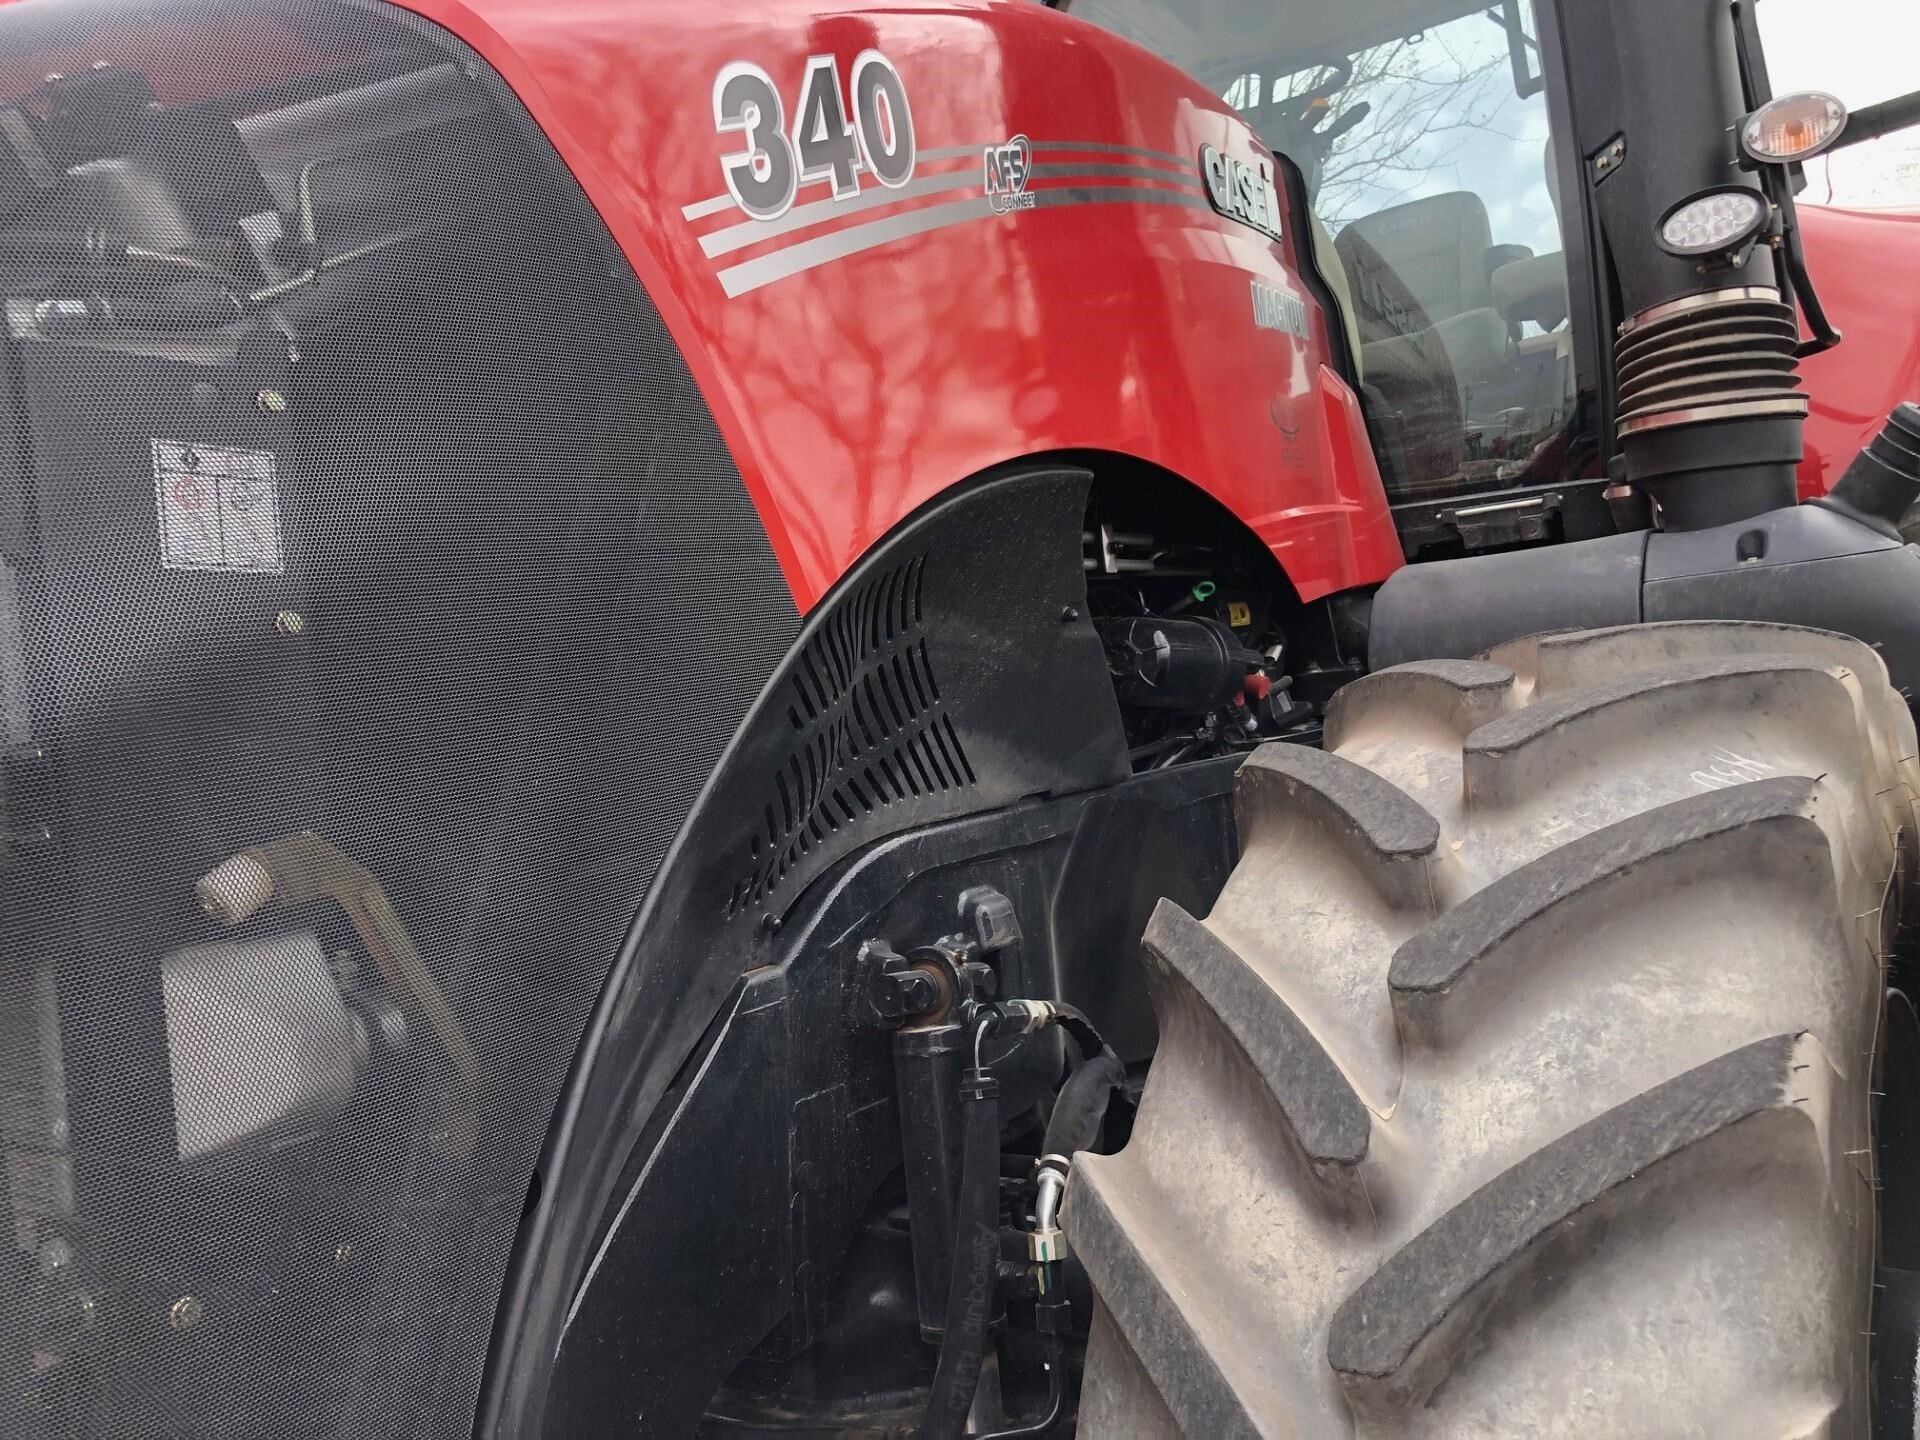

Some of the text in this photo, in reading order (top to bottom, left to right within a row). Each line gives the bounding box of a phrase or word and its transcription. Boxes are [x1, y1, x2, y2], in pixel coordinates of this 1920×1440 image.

[712, 48, 915, 222] 340
[984, 145, 1025, 194] AFS
[1001, 192, 1036, 210] CONNECT
[962, 1221, 997, 1336] Aeroquip
